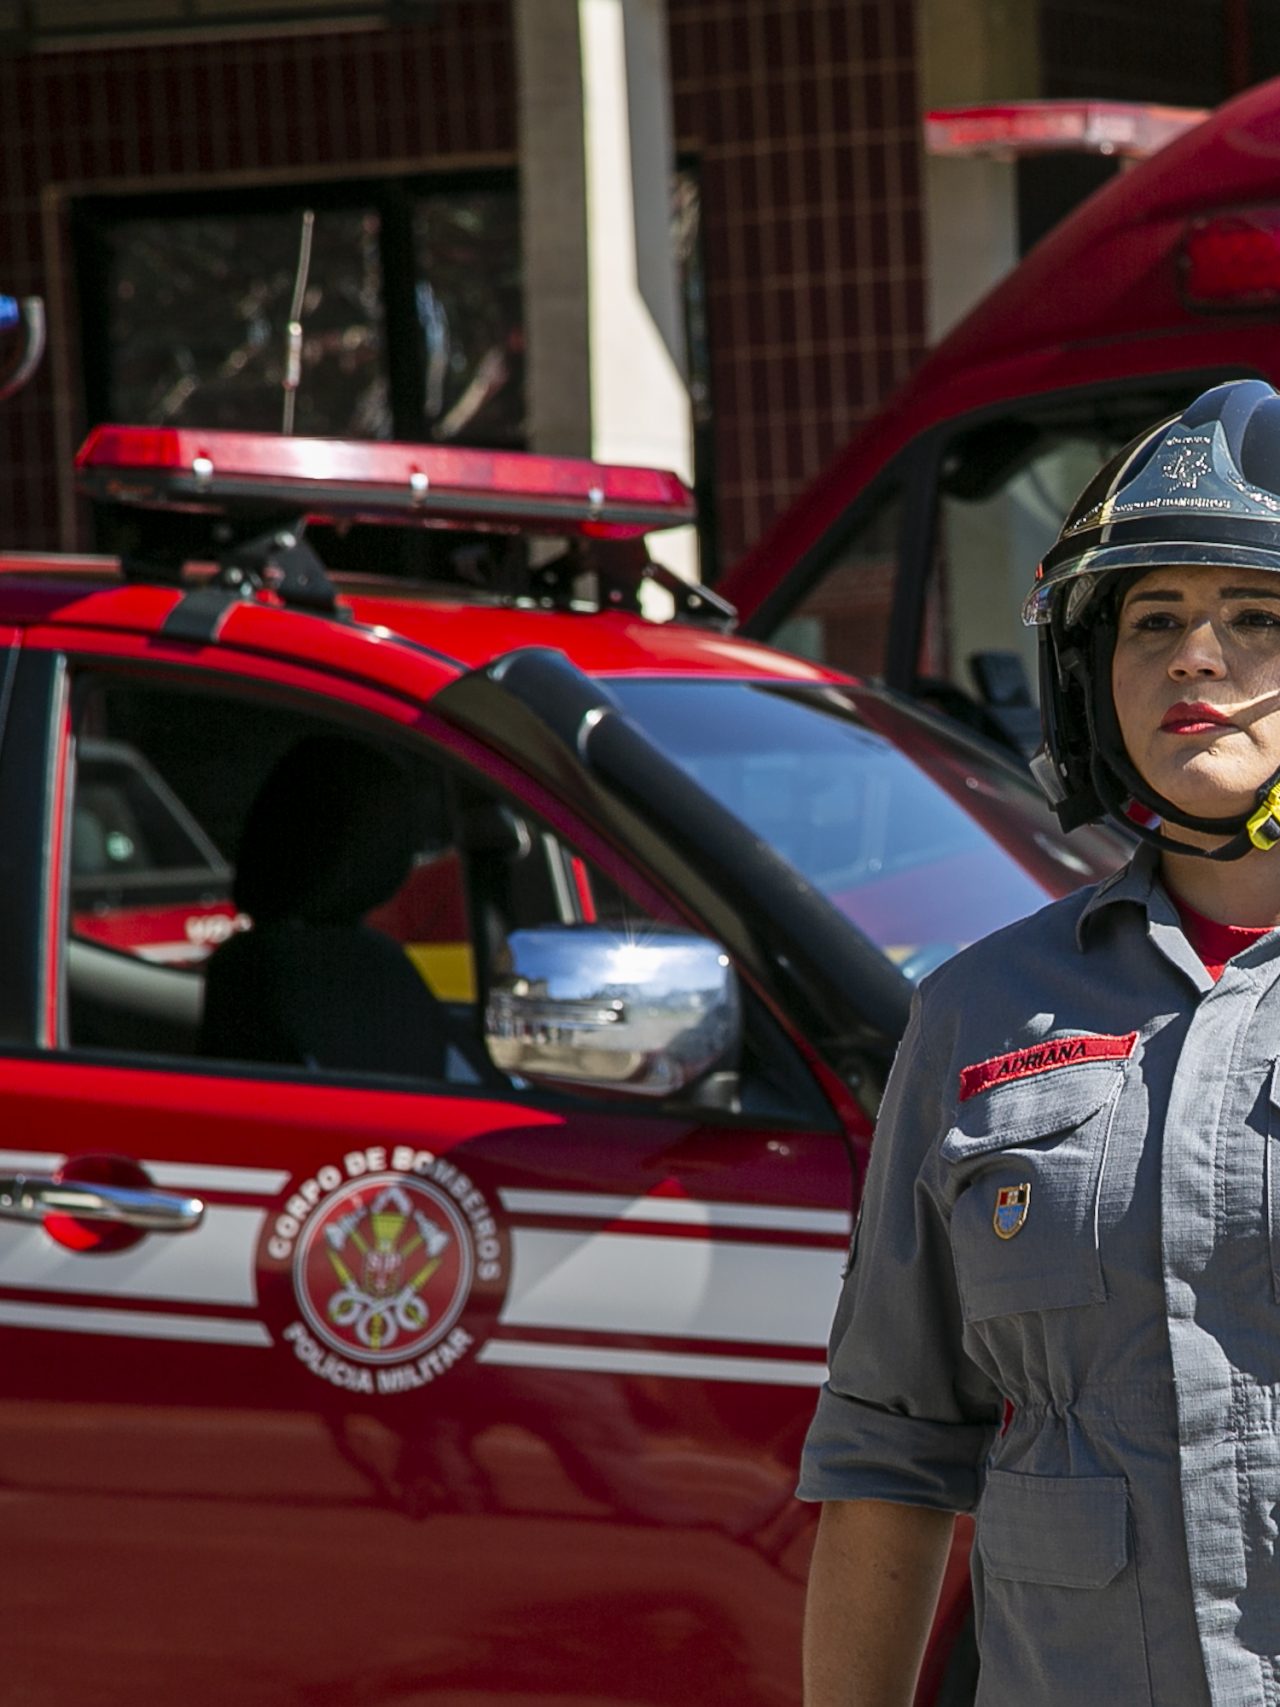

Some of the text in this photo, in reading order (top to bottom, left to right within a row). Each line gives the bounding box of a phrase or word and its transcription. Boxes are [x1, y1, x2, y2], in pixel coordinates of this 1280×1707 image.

[998, 1041, 1087, 1076] ADRIANA
[268, 1146, 500, 1281] CORPO DE BOMBEIROS
[377, 1327, 473, 1394] MILITAR
